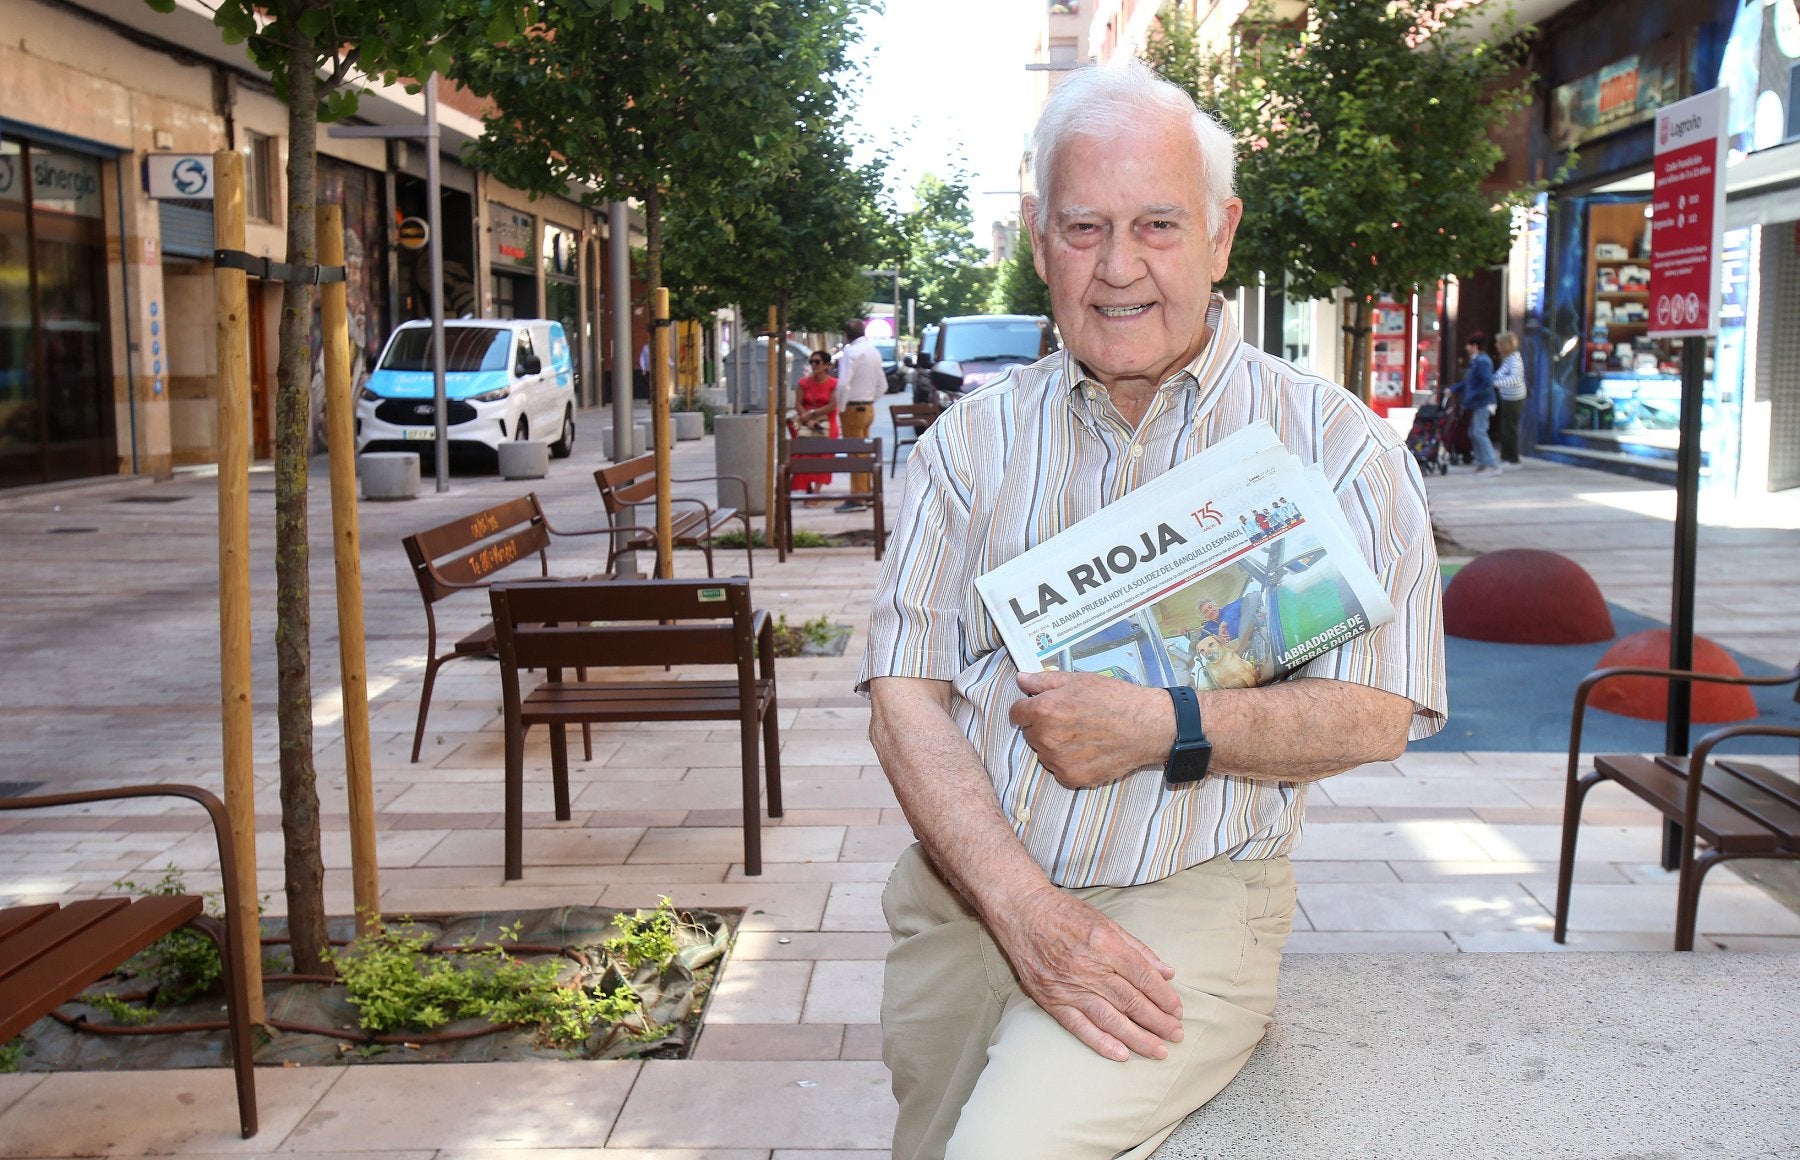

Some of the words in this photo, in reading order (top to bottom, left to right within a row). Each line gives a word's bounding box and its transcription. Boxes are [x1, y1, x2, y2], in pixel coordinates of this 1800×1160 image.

[1671, 114, 1702, 137] Logroño
[1191, 500, 1223, 528] 135
[1009, 582, 1068, 625] LA
[1067, 523, 1188, 595] RIOJA
[1050, 608, 1082, 629] ALBANIA
[1080, 595, 1109, 614] PRUEBA
[1107, 587, 1124, 600] HOY
[1122, 582, 1133, 592] LA
[1131, 569, 1160, 588] SOLIDEZ
[1159, 562, 1174, 574] DEL
[1172, 542, 1212, 567] BANQUILLO
[1210, 526, 1243, 547] ESPAÑOL
[1276, 621, 1348, 664] LABRADORES
[1345, 613, 1363, 628] DE
[1284, 643, 1329, 670] TIERRAS
[1328, 624, 1366, 647] DURAS
